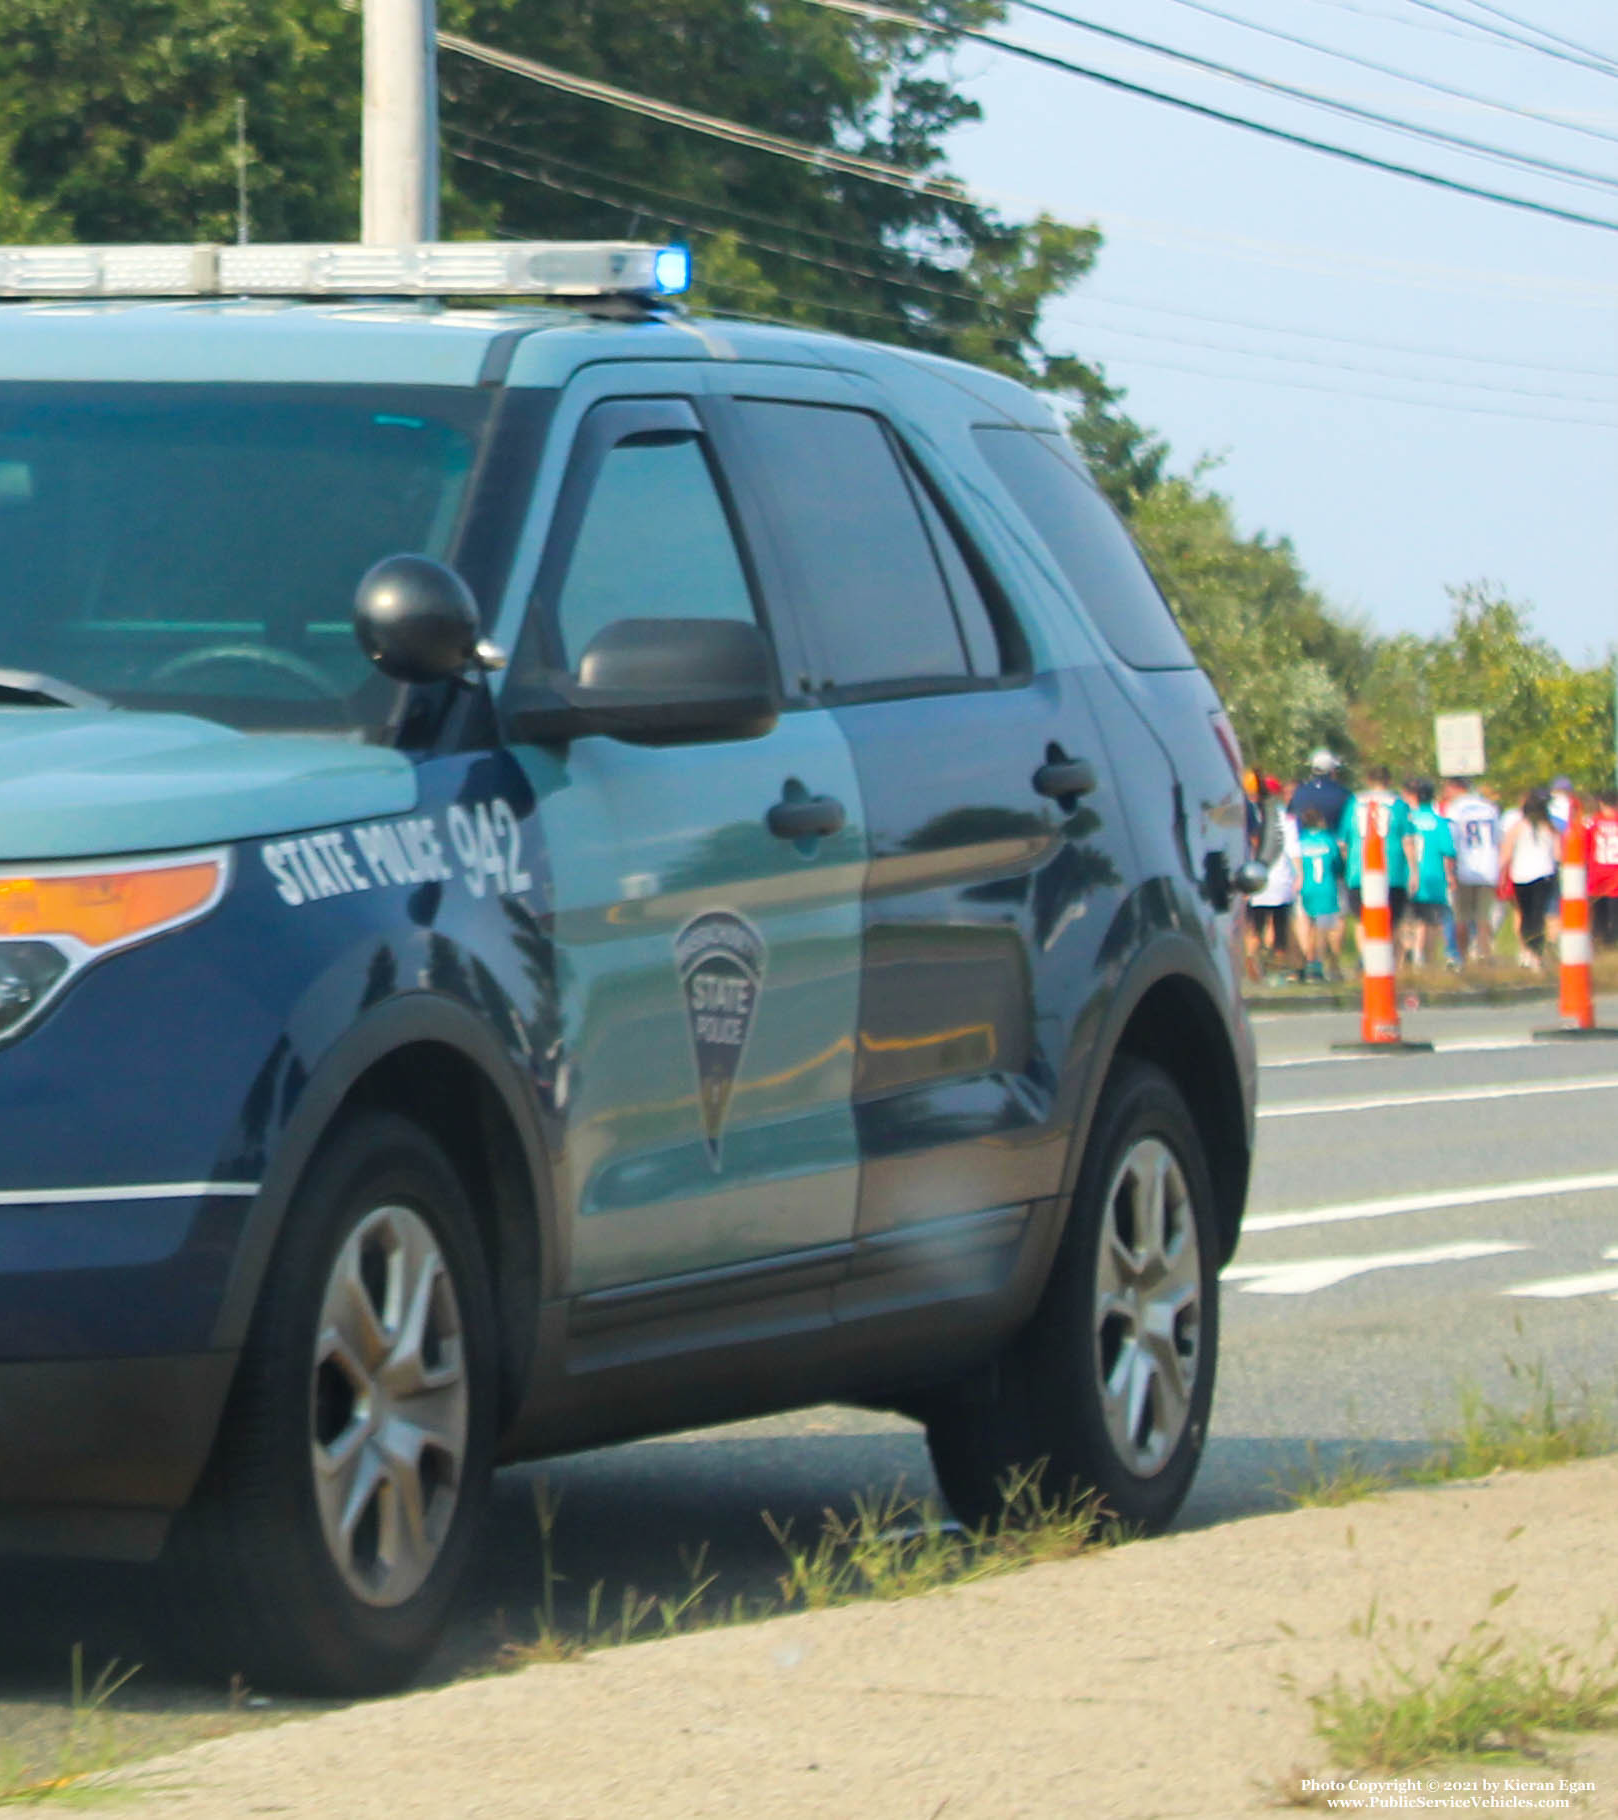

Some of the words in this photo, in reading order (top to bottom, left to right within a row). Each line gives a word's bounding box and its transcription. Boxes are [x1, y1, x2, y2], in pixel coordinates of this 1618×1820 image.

[261, 832, 371, 906] STATE
[352, 817, 453, 886] POLICE
[446, 797, 532, 898] 942
[691, 973, 750, 1014] STATE
